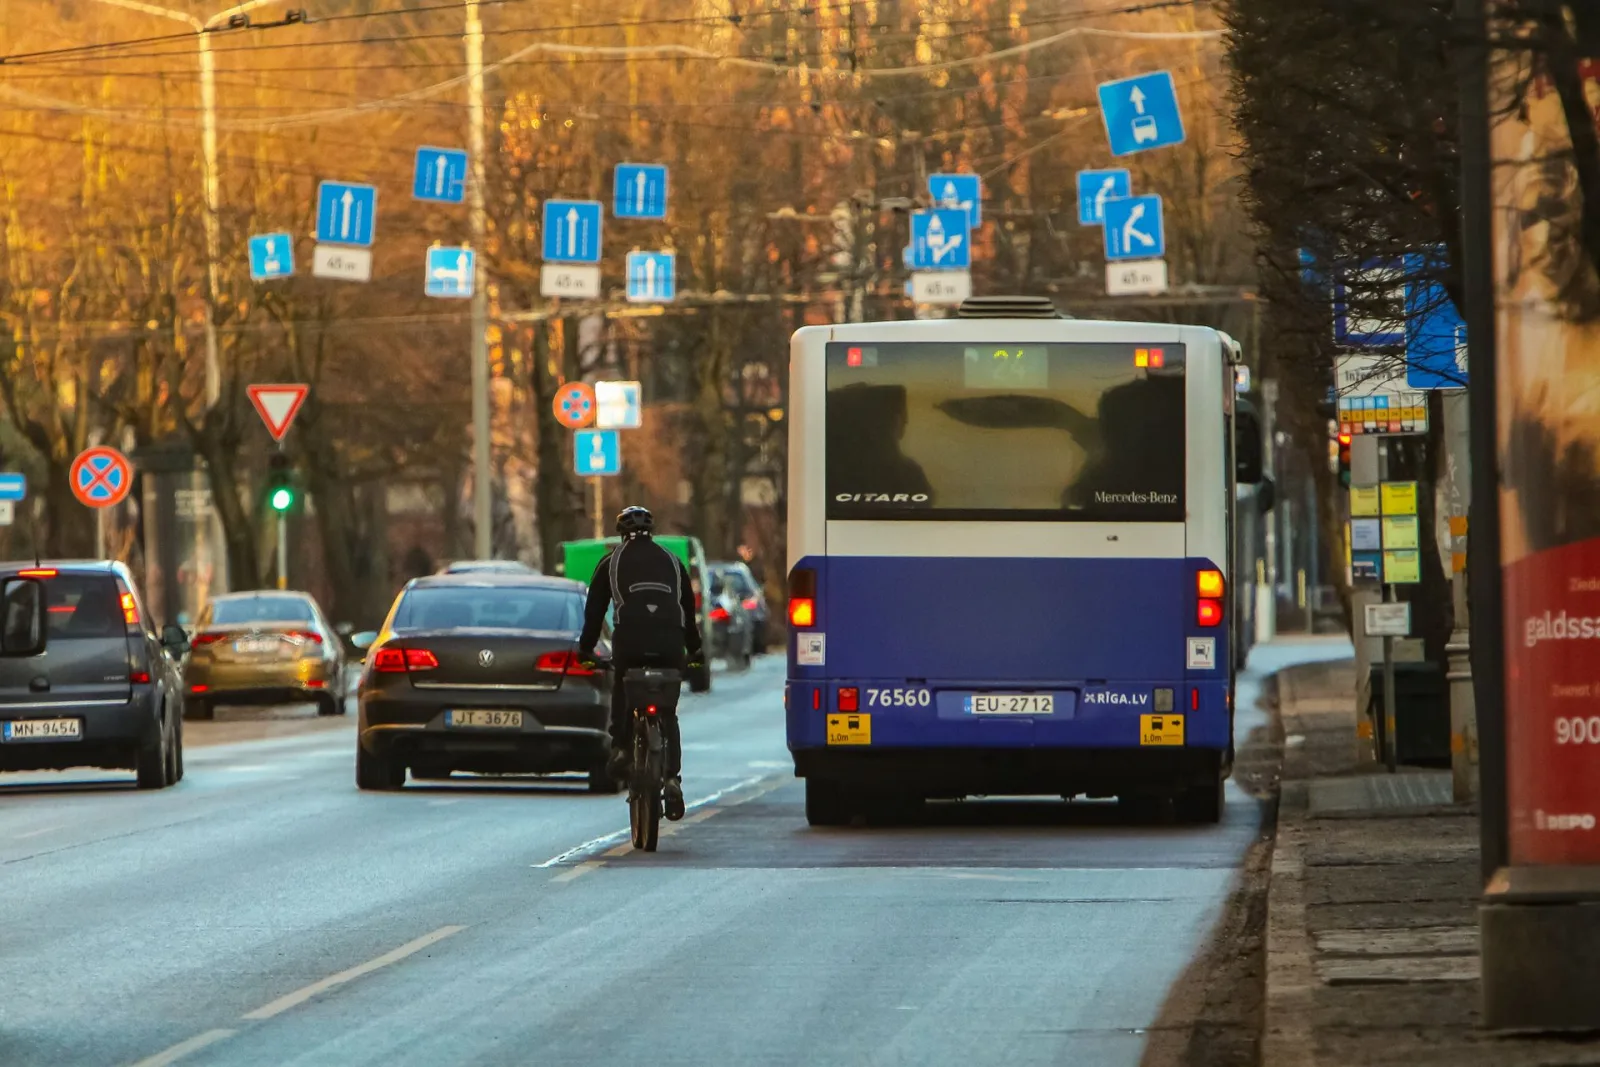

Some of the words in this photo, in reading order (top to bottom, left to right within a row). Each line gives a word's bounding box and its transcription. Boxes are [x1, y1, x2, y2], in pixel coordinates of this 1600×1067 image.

[835, 493, 928, 502] CITARO
[1094, 490, 1178, 503] Mercedes-Benz
[866, 689, 930, 707] 76560
[975, 697, 1051, 712] EU-2712
[455, 711, 520, 726] JT-3676
[14, 723, 77, 737] MN-9454
